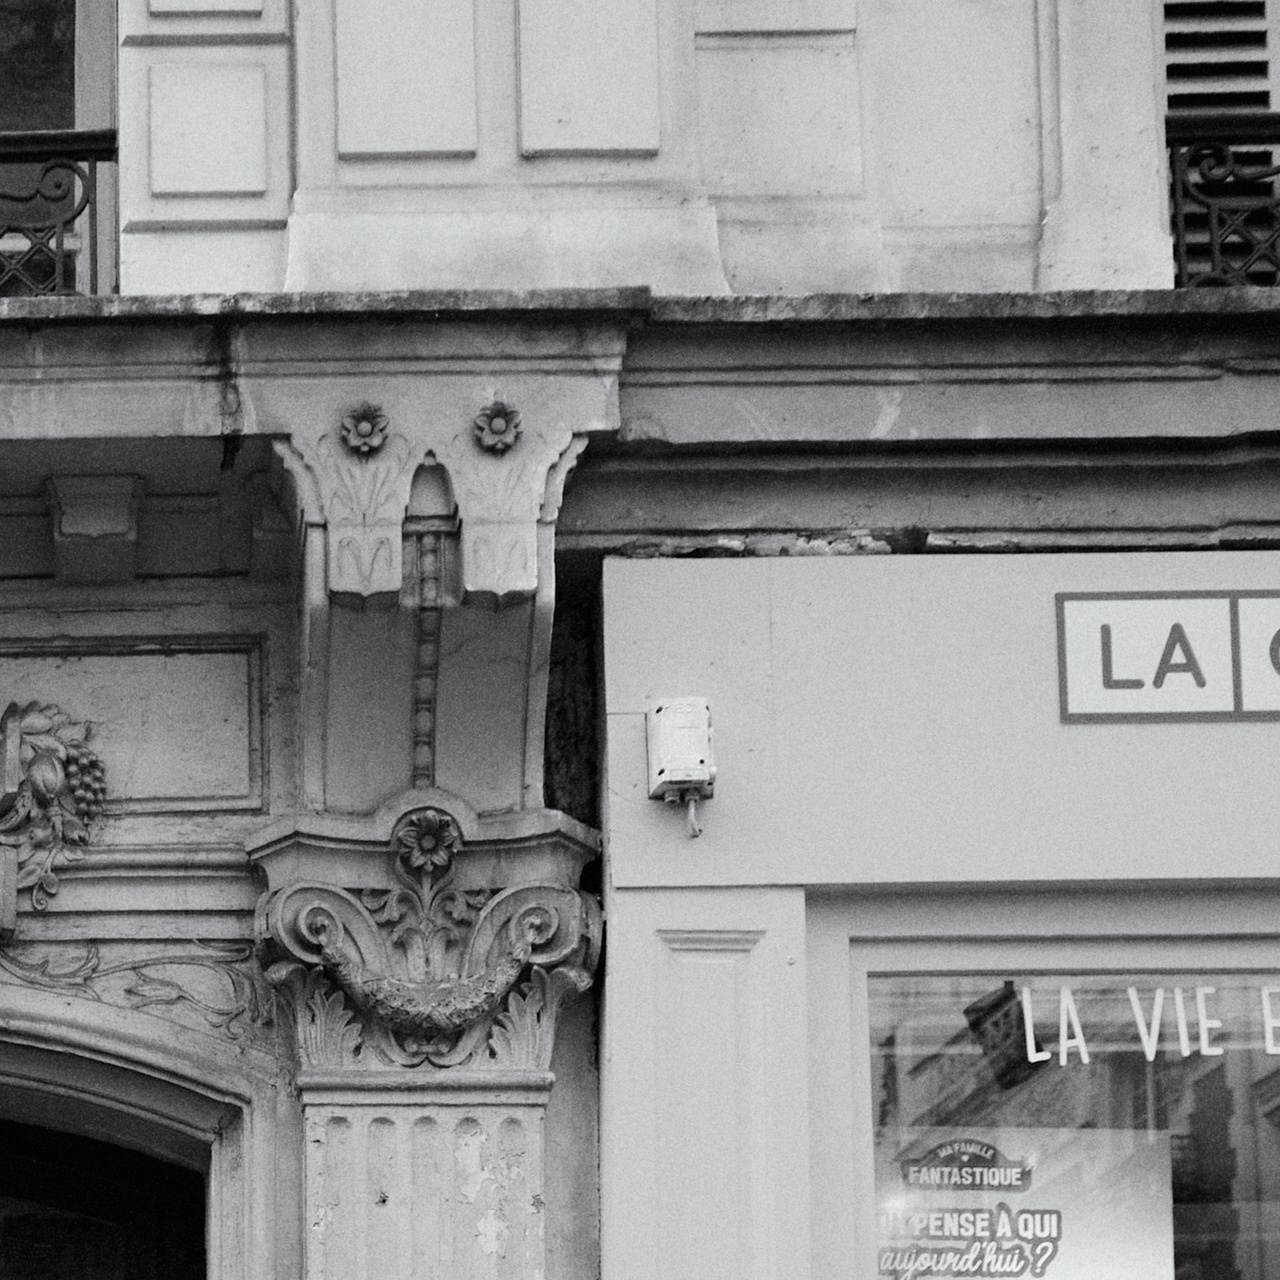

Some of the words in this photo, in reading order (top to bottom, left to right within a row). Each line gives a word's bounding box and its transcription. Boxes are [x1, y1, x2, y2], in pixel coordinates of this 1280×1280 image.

[1100, 622, 1207, 690] LA
[1021, 985, 1091, 1067] LA
[1127, 985, 1225, 1062] VIE
[954, 1142, 995, 1161] FAMILLE
[908, 1166, 1023, 1186] FANTASTIQUE
[912, 1212, 991, 1238] PENSE
[1017, 1212, 1059, 1240] QUI
